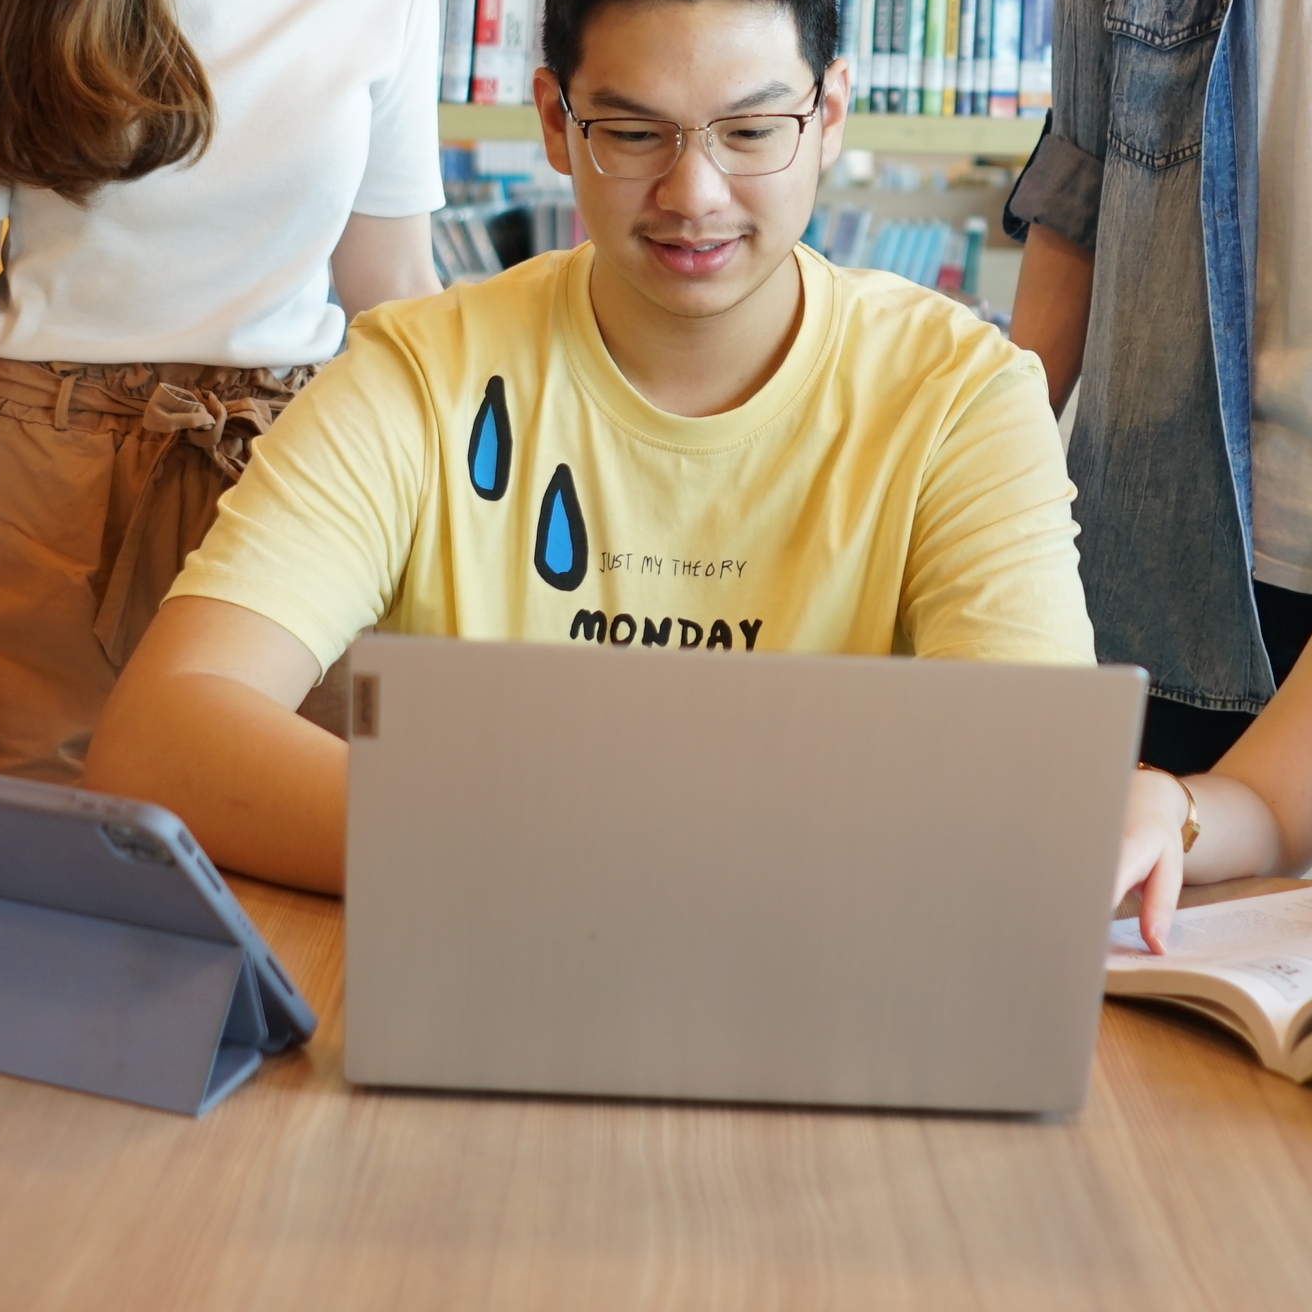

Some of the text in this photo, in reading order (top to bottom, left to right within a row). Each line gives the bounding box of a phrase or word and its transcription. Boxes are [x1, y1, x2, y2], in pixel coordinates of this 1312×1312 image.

[599, 552, 747, 579] JUST MY THEORY
[570, 609, 763, 653] MONDAY
